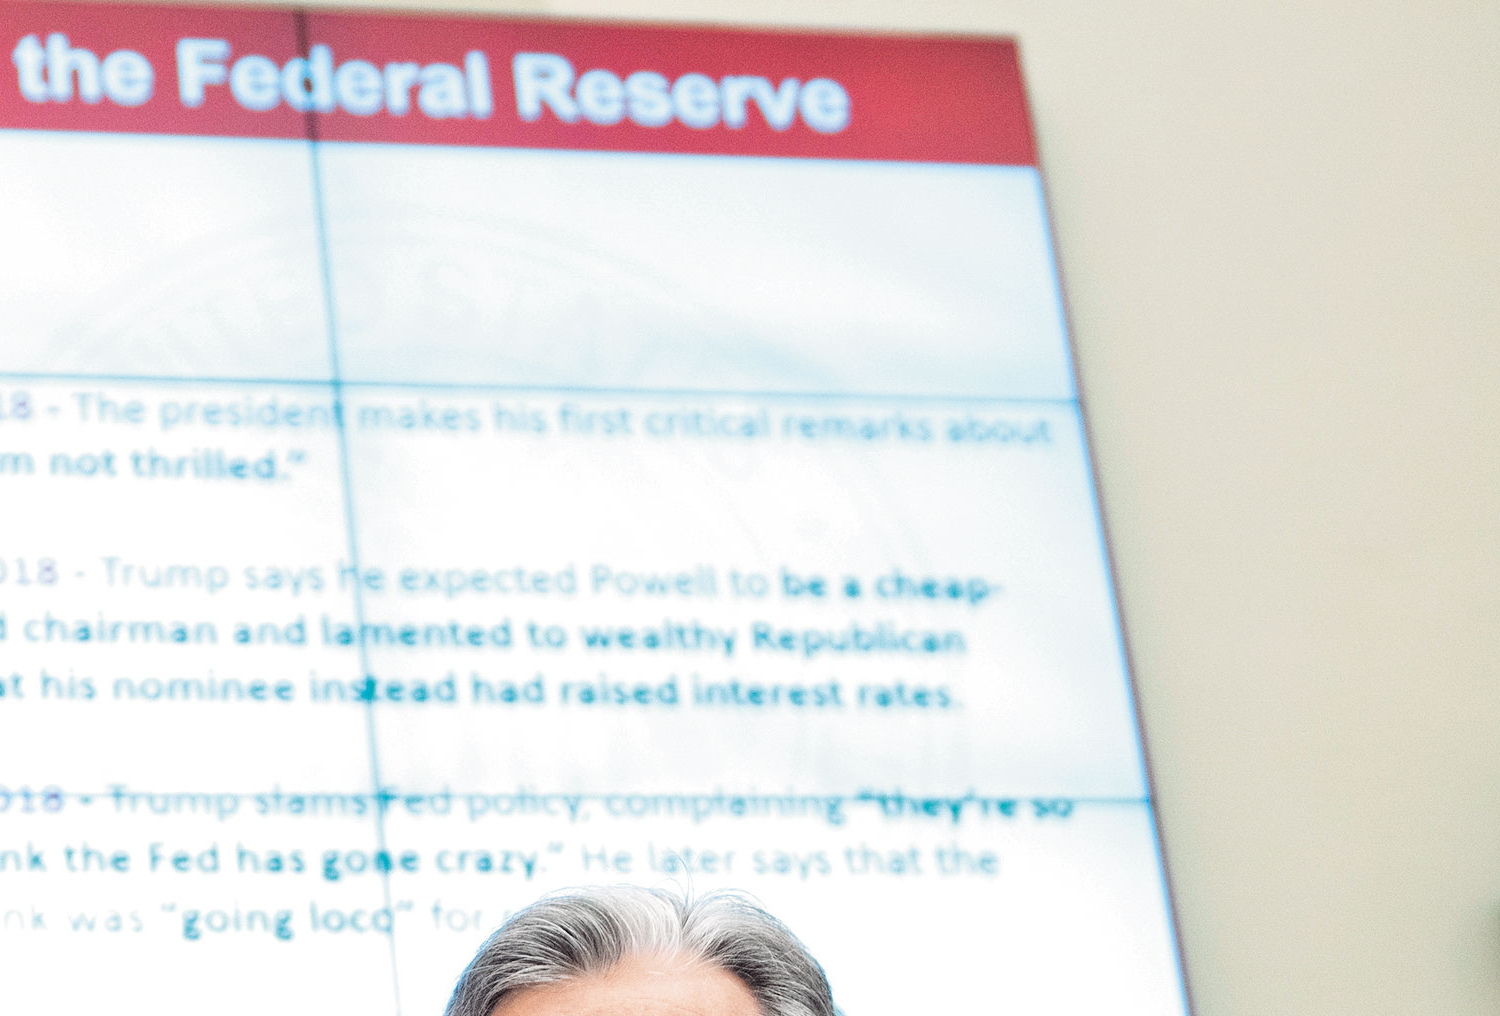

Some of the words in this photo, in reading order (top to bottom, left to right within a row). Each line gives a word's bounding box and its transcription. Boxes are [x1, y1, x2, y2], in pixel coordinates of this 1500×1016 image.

[13, 33, 154, 105] the
[175, 38, 495, 120] Federal
[511, 52, 853, 131] Reserve
[71, 392, 145, 424] The
[160, 393, 341, 431] president
[357, 397, 482, 434] makes
[494, 402, 548, 436] his
[559, 404, 634, 438] first
[645, 405, 771, 439] critical
[781, 414, 932, 442] remarks
[946, 411, 1054, 445] about
[49, 448, 117, 478] not
[101, 556, 229, 594] Trump
[243, 562, 325, 596] says
[400, 565, 578, 596] expected
[591, 566, 718, 596] Powell
[729, 569, 770, 596] to
[781, 566, 828, 599] be
[844, 575, 862, 599] a
[876, 569, 1002, 606] cheap-
[23, 611, 218, 644] chairman
[233, 615, 305, 646] and
[322, 612, 512, 650] lamented
[526, 621, 568, 650] to
[581, 621, 738, 658] wealthy
[752, 621, 966, 659] Republican
[41, 669, 96, 700] his
[112, 673, 295, 702] nominee
[310, 668, 457, 702] instead
[471, 671, 546, 704] had
[561, 674, 679, 706] raised
[692, 674, 845, 708] interest
[857, 677, 961, 709] rates.
[105, 784, 241, 820] Trump
[253, 784, 368, 816] slams
[376, 786, 452, 818] Fed
[468, 790, 590, 825] policy,
[606, 792, 845, 826] complaining
[1031, 798, 1074, 820] so
[64, 843, 131, 873] the
[149, 843, 220, 874] Fed
[238, 844, 306, 874] has
[322, 849, 420, 882] gone
[581, 842, 631, 874] He
[648, 844, 734, 875] later
[754, 848, 831, 882] says
[845, 845, 922, 876] that
[936, 844, 999, 876] the
[68, 909, 145, 934] was
[432, 903, 482, 932] for
